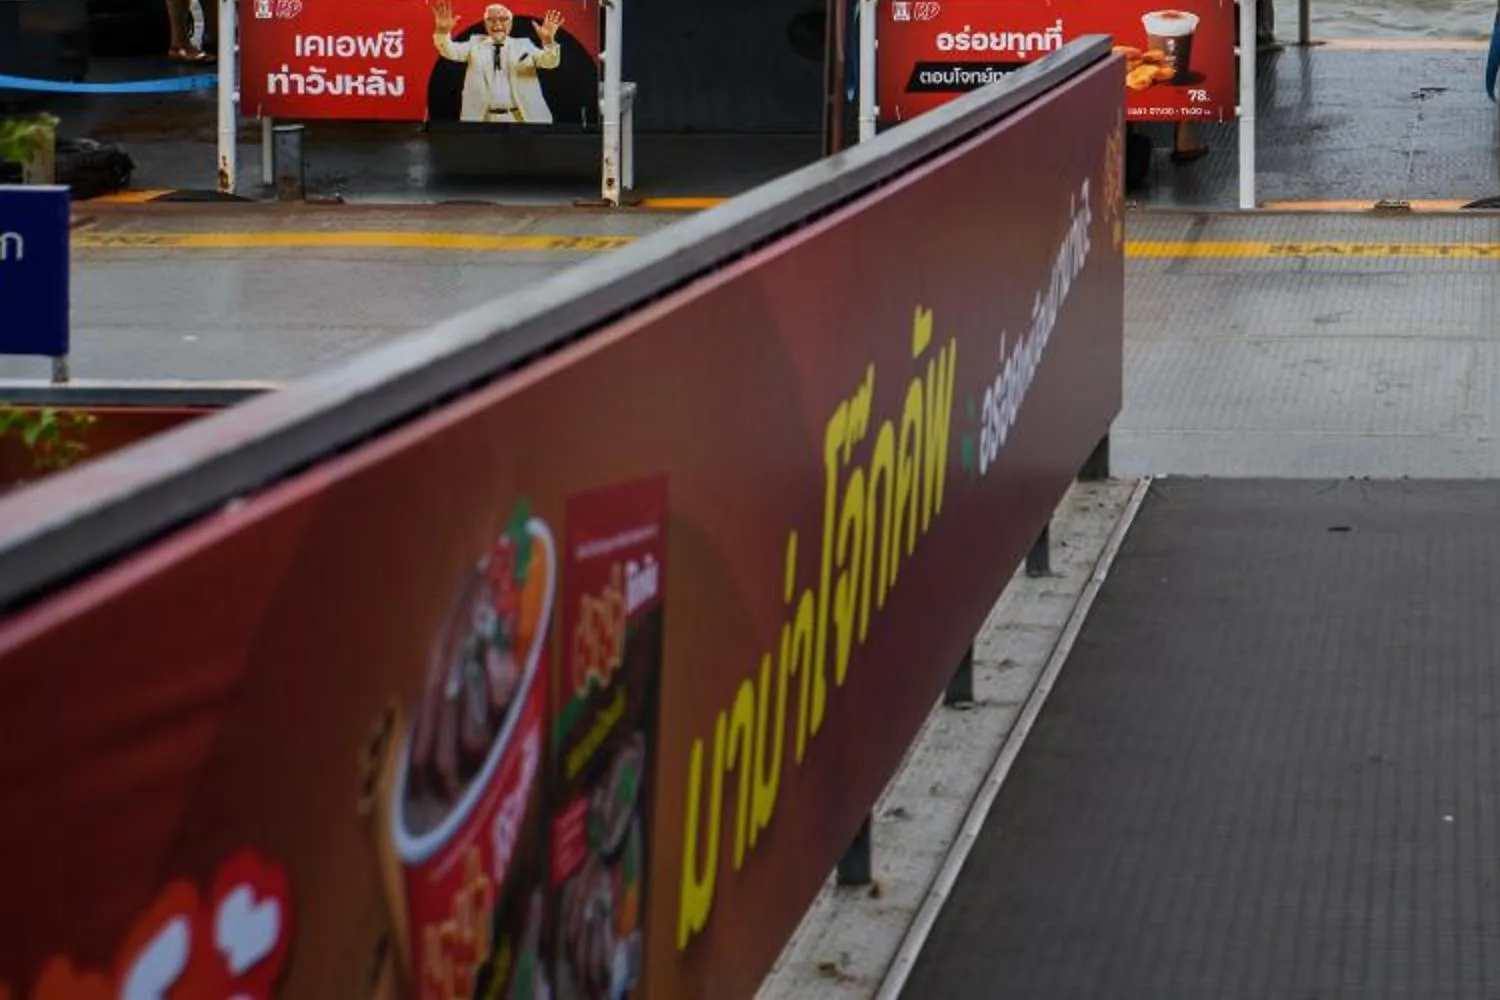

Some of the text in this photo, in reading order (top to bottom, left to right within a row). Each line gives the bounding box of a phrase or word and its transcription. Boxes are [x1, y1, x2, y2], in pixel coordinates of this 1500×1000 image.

[294, 28, 404, 59] เคเอฟซี
[936, 18, 1064, 59] อร่อยทุกที่
[267, 64, 405, 97] ท่าวังหลัง
[677, 305, 957, 951] มาม่าโจ๊กคัพ
